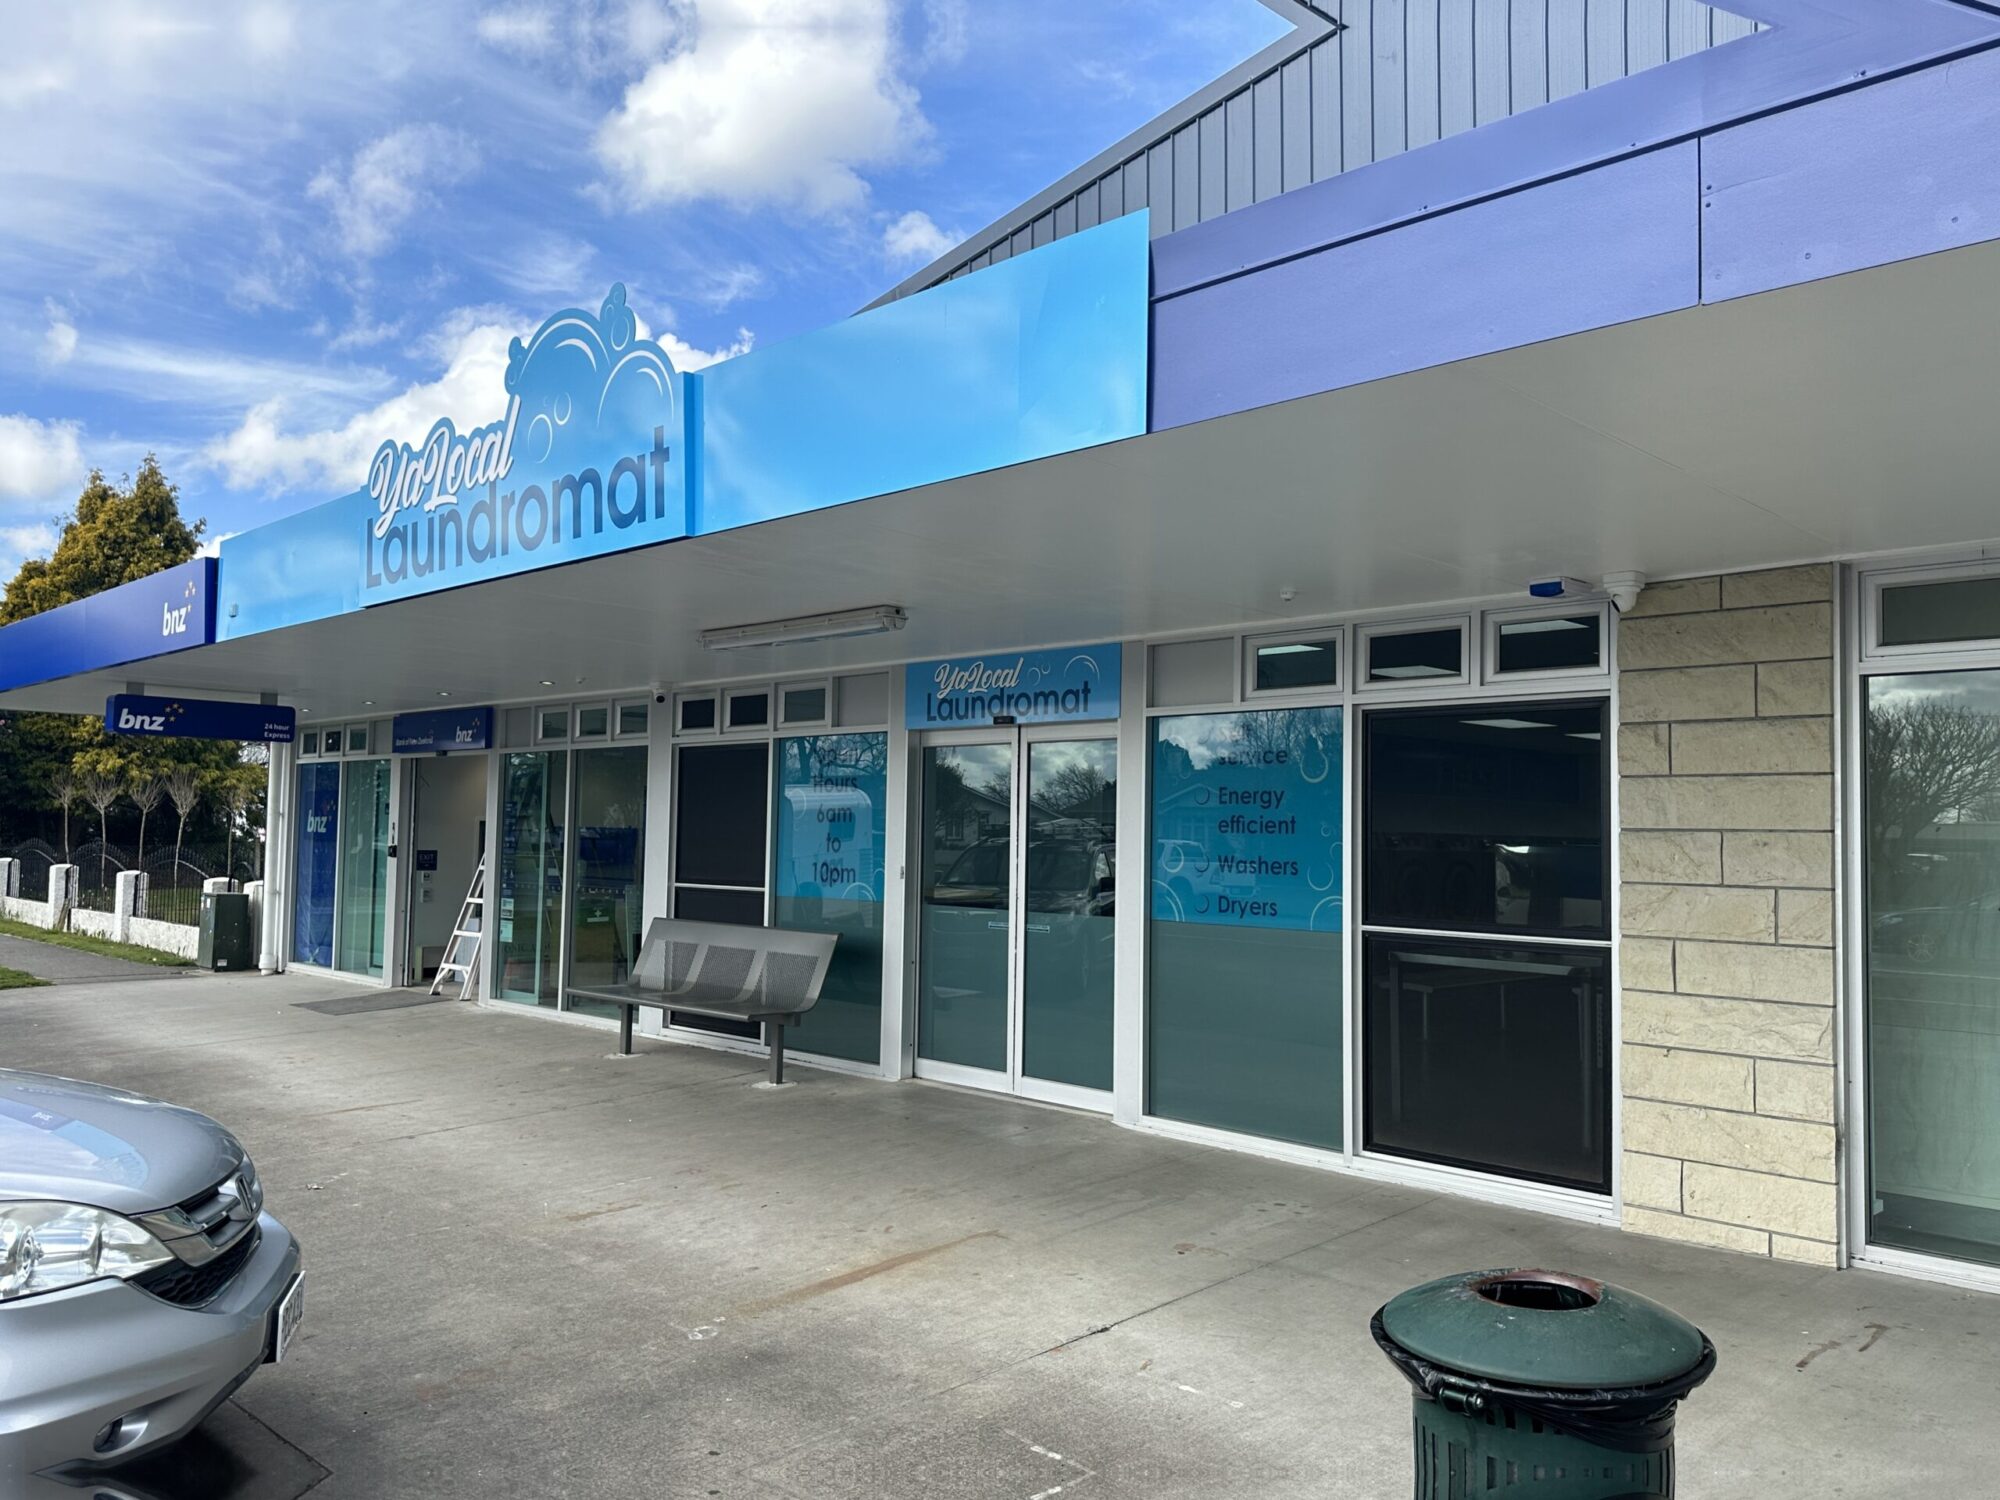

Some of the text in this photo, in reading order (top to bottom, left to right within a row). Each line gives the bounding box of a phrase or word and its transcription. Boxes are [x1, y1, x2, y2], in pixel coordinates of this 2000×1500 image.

[366, 425, 670, 589] Laundromat
[162, 601, 188, 637] bnz
[926, 680, 1091, 722] Laundromat
[118, 707, 166, 732] bnz
[455, 725, 473, 743] bnz
[813, 773, 858, 793] Hours
[1218, 786, 1285, 809] Energy
[307, 809, 328, 833] bnz
[816, 803, 852, 823] 6am
[1218, 815, 1296, 835] efficient
[826, 832, 842, 853] to
[812, 861, 856, 887] 10pm
[1218, 855, 1299, 876] Washers
[1218, 895, 1278, 919] Dryers
